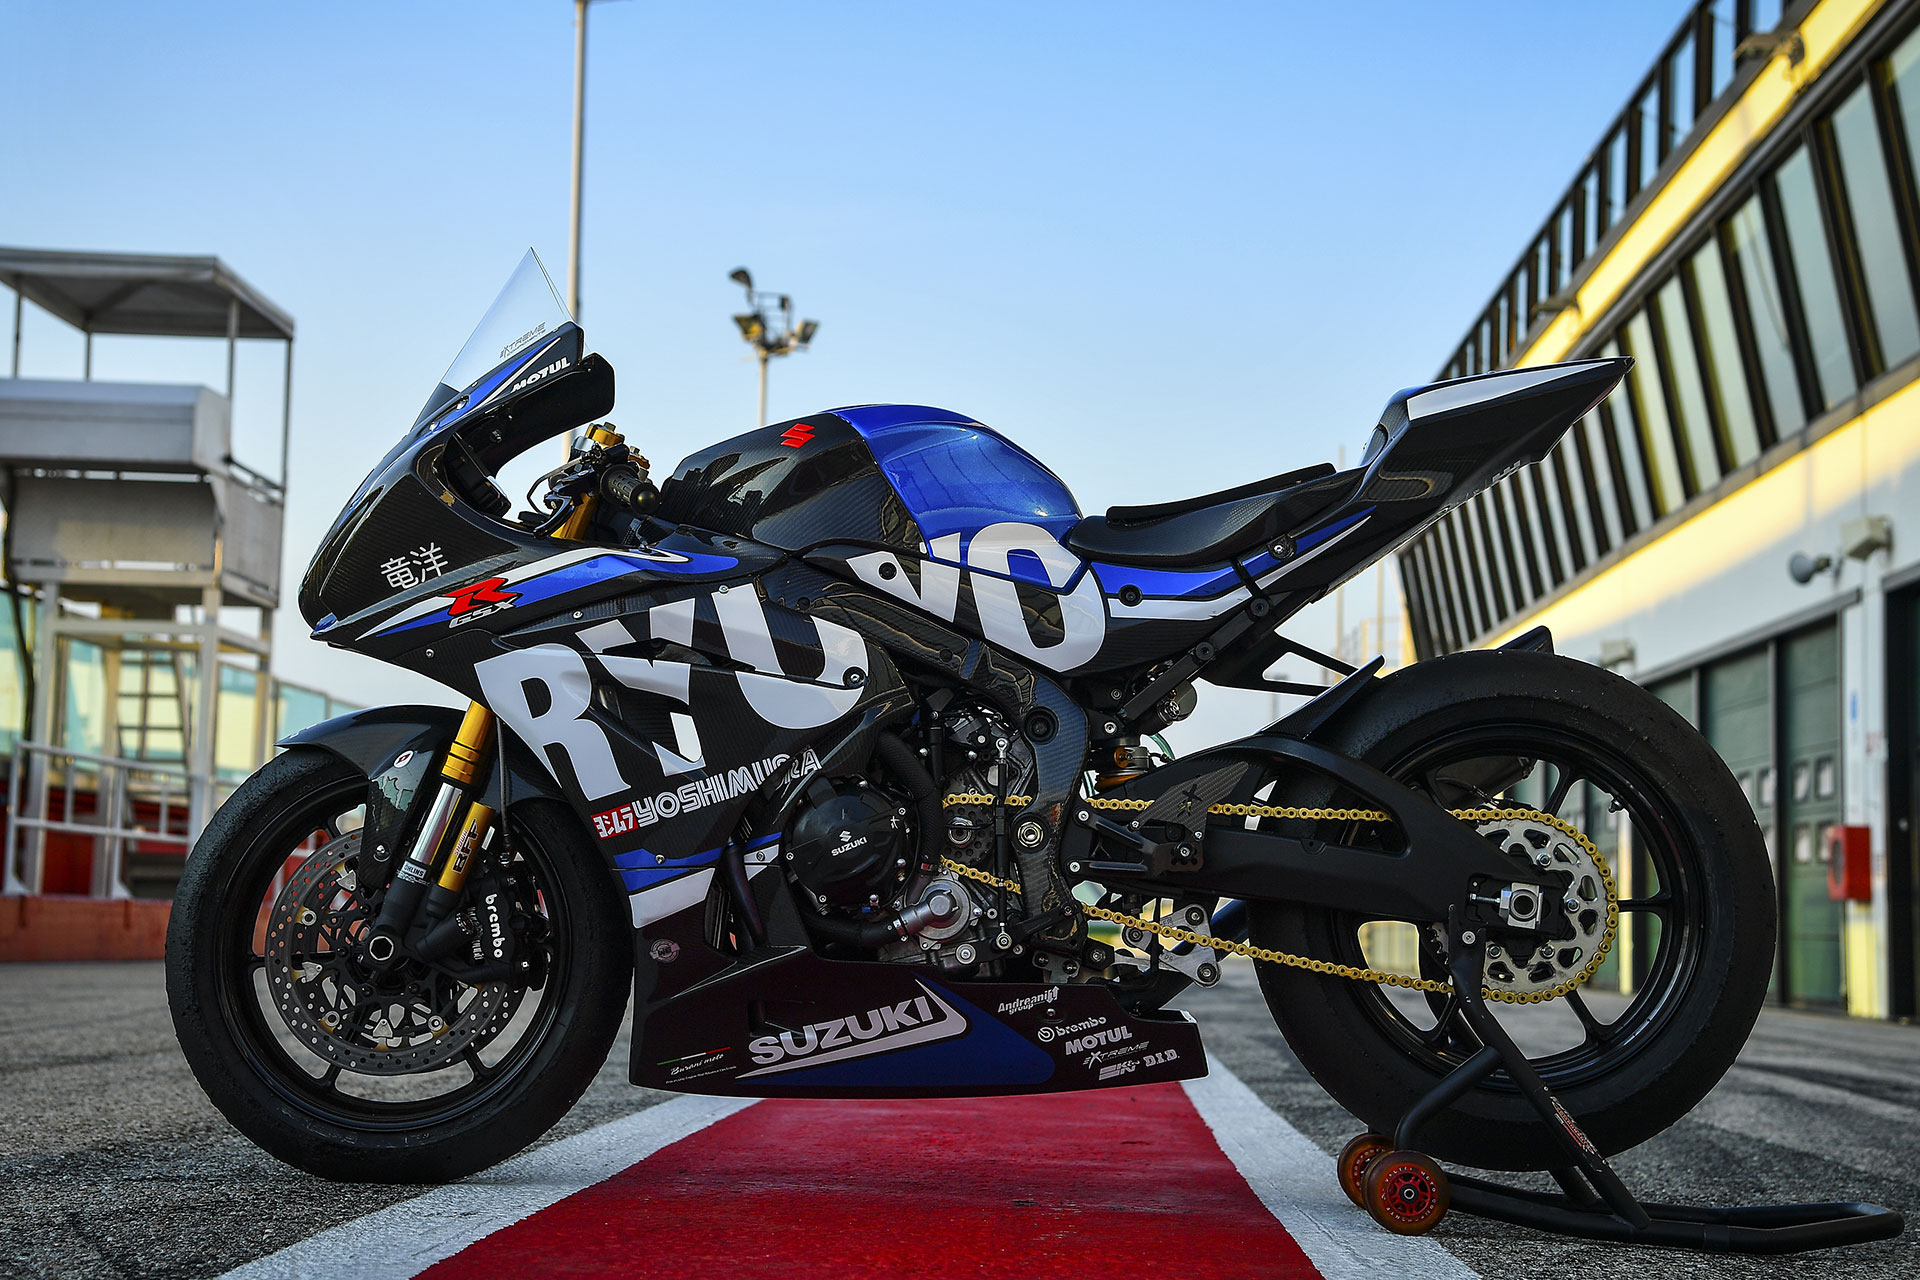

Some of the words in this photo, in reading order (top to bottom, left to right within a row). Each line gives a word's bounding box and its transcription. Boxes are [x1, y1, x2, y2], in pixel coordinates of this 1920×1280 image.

[511, 357, 571, 393] MOTUL
[380, 542, 449, 589] 竜洋
[831, 836, 868, 857] SUZUKI
[485, 893, 506, 959] brembo
[997, 989, 1048, 1013] Andreani
[748, 996, 934, 1065] SUZUKI
[1056, 1016, 1107, 1037] brembo
[1065, 1025, 1133, 1056] MOTUL
[1143, 1049, 1181, 1067] D.I.D.
